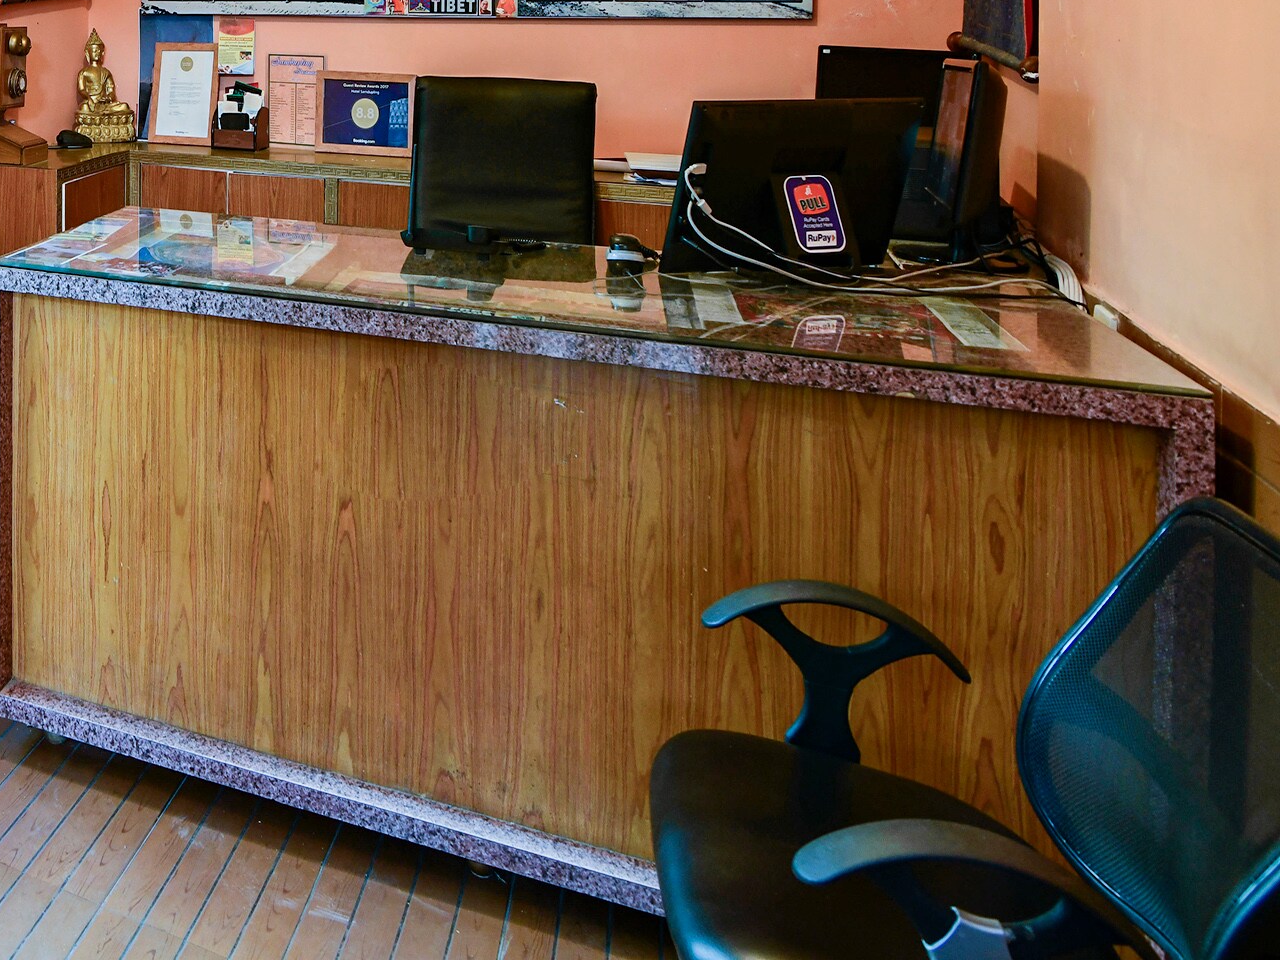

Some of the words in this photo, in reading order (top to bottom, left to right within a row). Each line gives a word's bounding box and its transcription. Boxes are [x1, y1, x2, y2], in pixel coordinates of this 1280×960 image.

[356, 107, 375, 119] 8.8
[799, 196, 827, 212] PULL
[807, 234, 831, 243] RuPay
